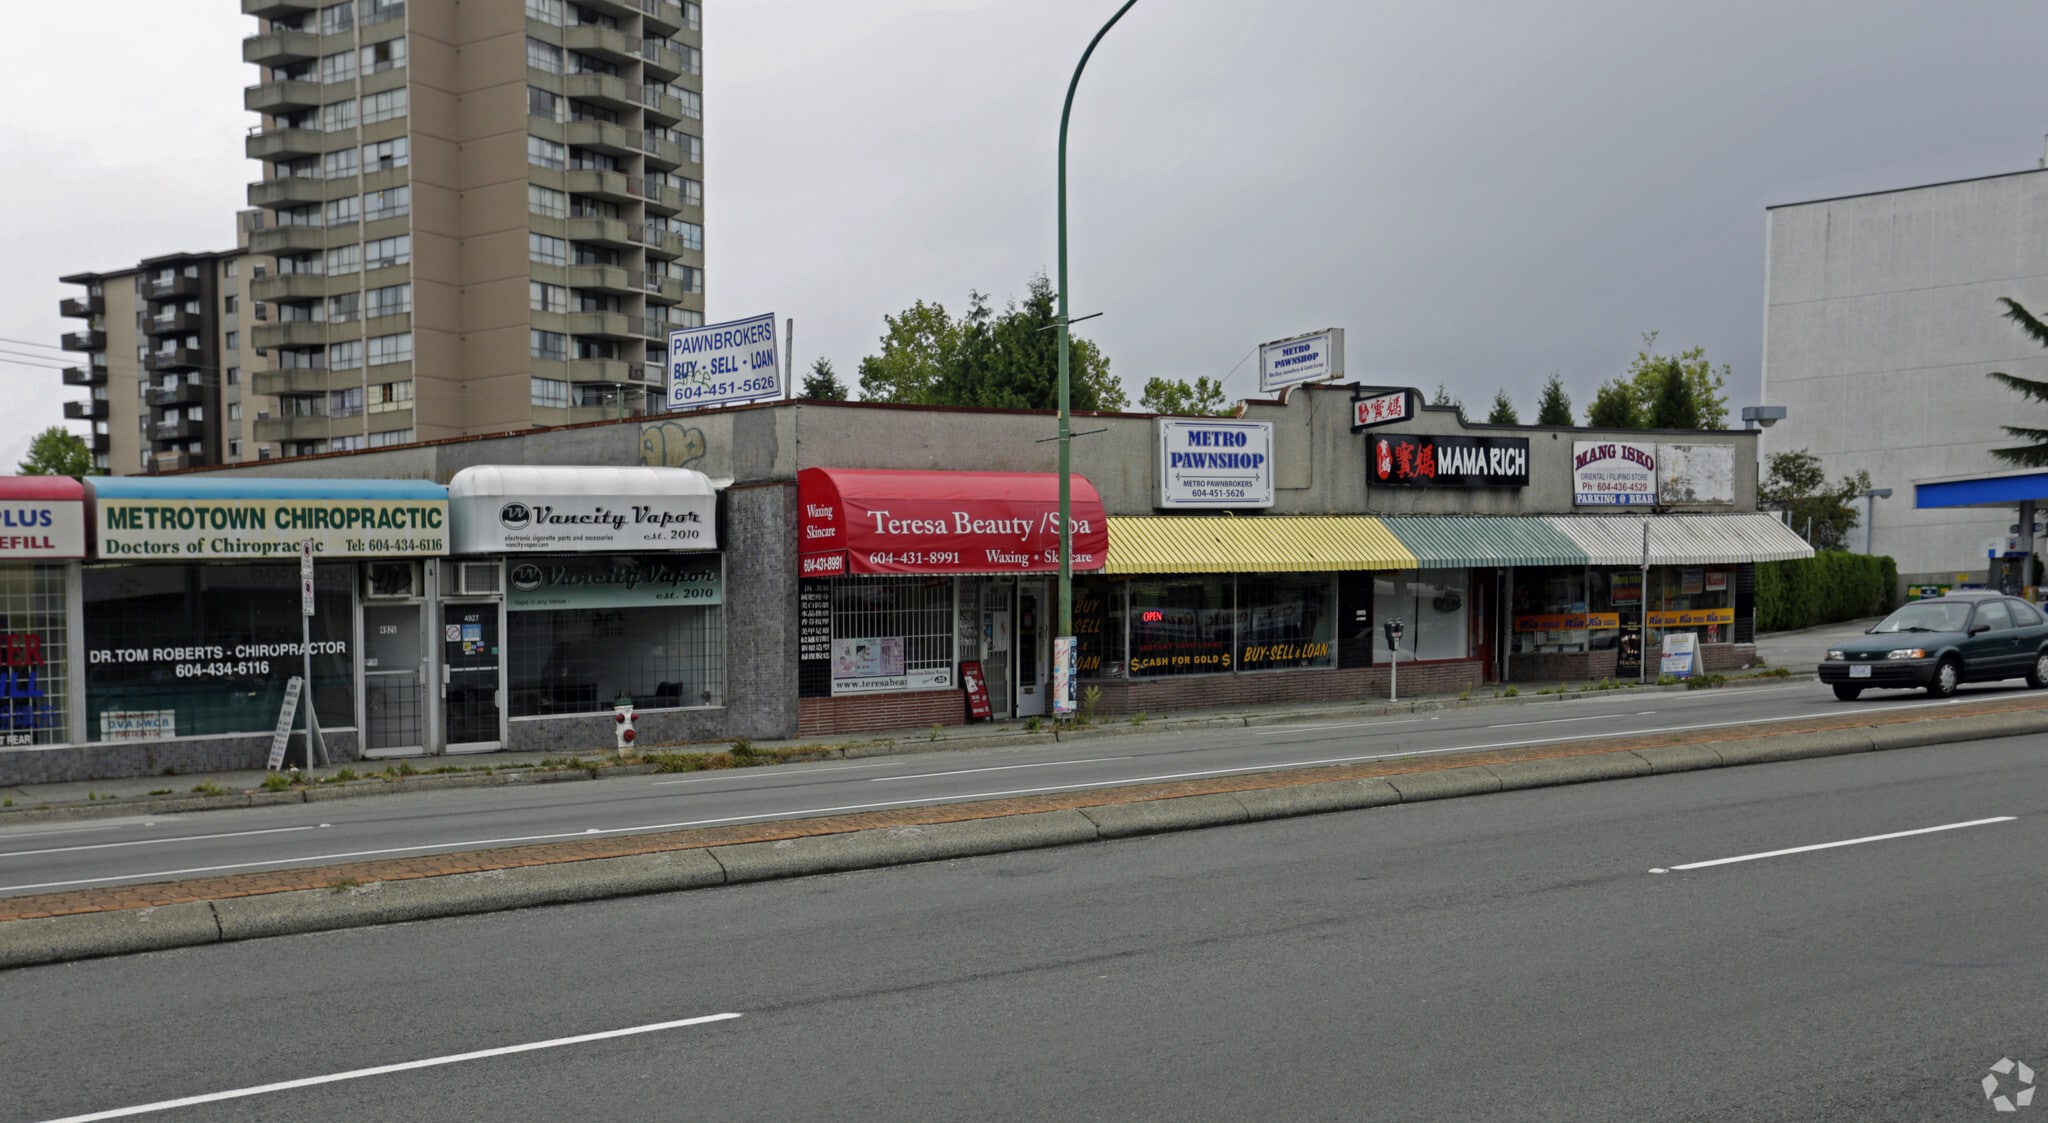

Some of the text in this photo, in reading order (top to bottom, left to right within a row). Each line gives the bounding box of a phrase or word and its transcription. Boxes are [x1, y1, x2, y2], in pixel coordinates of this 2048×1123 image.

[674, 322, 772, 356] PAWNBROKERS
[1282, 343, 1311, 357] METRO
[674, 360, 697, 380] BUY
[711, 355, 739, 376] SELL
[751, 348, 774, 370] LOAN
[1274, 352, 1319, 369] PAWNSHOP
[674, 376, 775, 400] 604-451-5626
[1187, 430, 1247, 448] METRO
[1170, 451, 1264, 469] PAWNSHOP
[1437, 446, 1526, 477] MAMA RICH
[1575, 444, 1654, 472] MANG ISKO
[1183, 480, 1253, 488] METRO PAWNBROKERS
[1580, 473, 1605, 481] ORIENTAL
[1609, 473, 1631, 481] FILIPINO
[1632, 473, 1649, 481] STORE
[1192, 489, 1245, 498] 604-451-5626
[1597, 482, 1648, 492] 604-436-4529
[1576, 494, 1617, 504] PARKING
[1628, 494, 1654, 503] REAR
[0, 509, 53, 528] LUS
[106, 507, 443, 530] METROTOWN CHIROPRACTIC
[532, 505, 703, 530] Vancity Vapor
[806, 504, 833, 520] Waxing
[806, 524, 836, 539] Skincare
[867, 510, 948, 535] Teresa
[952, 511, 1034, 541] Beauty
[504, 534, 531, 542] electronic
[532, 534, 556, 543] cigarette
[557, 534, 572, 542] parts
[670, 530, 700, 540] 2010
[105, 537, 443, 556] Doctors of Chiropracic Tel: 604-434-6116
[803, 556, 843, 572] 604-431-8991
[869, 549, 1092, 567] 604-431-8991 Waxing Skcare
[545, 563, 716, 590] Vancity Vapor
[683, 588, 714, 599] 2010
[1074, 599, 1101, 615] BUY
[1142, 611, 1163, 622] OPEN
[1073, 618, 1102, 634] SELL
[0, 633, 44, 667] ER
[90, 649, 149, 664] DR.TOM
[152, 647, 223, 662] ROBERTS
[235, 641, 346, 657] CHIROPRACTOR
[1302, 642, 1329, 660] LOAN
[1077, 655, 1102, 671] OAN
[1142, 656, 1169, 667] CASH
[1171, 655, 1191, 665] FOR
[1193, 654, 1219, 664] GOLD
[176, 661, 270, 678] 604-434-6116
[7, 734, 31, 745] REAR
